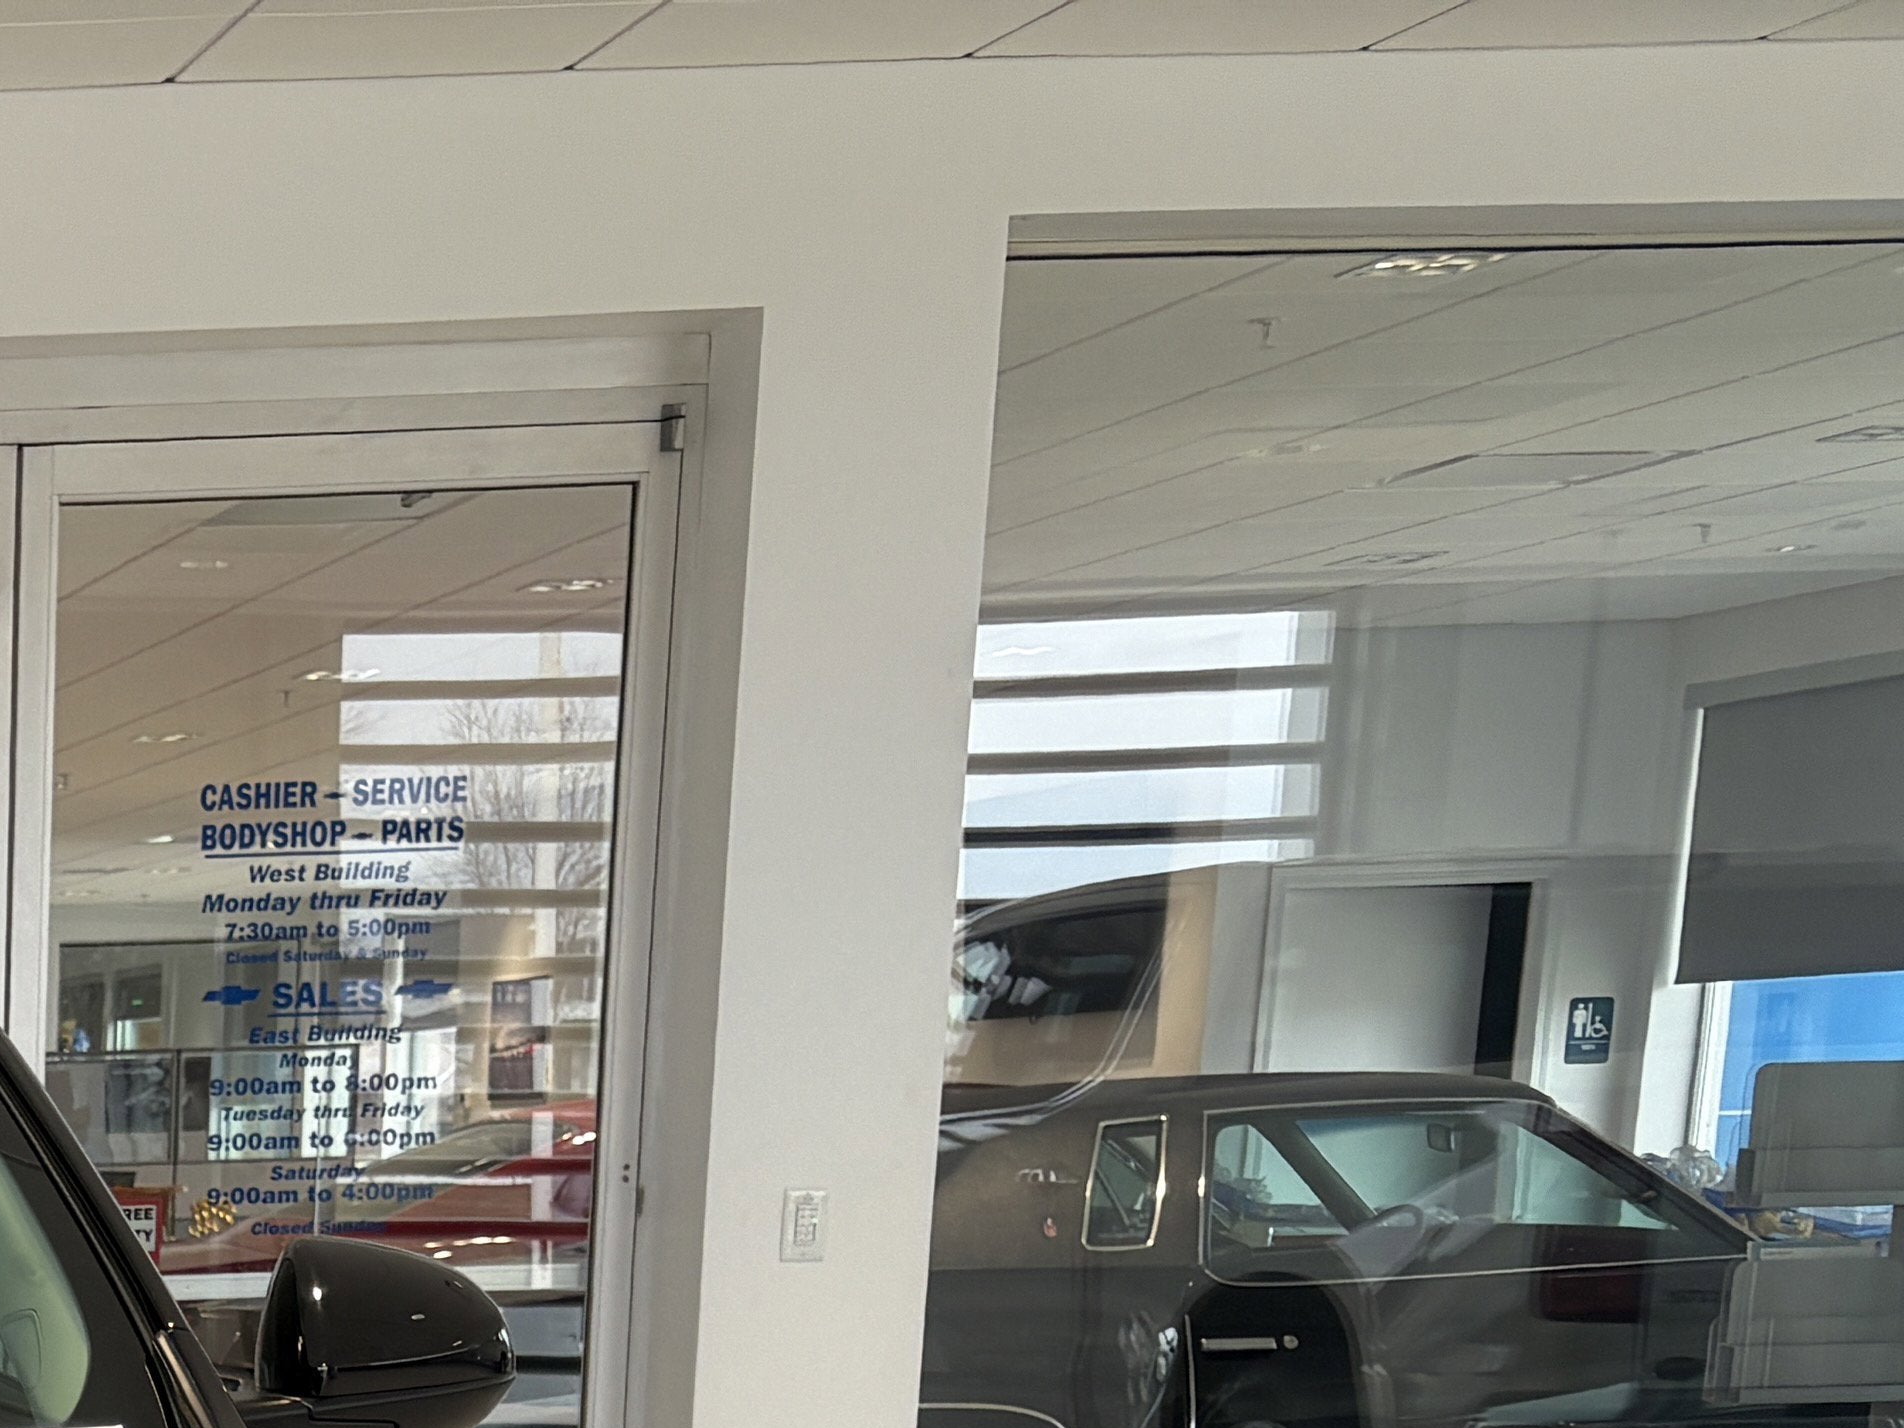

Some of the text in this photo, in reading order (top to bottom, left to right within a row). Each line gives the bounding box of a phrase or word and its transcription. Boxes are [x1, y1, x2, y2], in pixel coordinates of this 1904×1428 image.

[200, 775, 468, 812] CASHIER SERVICE
[201, 816, 464, 851] BODYSHOP PARTS
[249, 861, 412, 883] West Building
[202, 888, 448, 916] Monday thru Friday
[224, 918, 432, 941] 7:30am to 5:00pm
[225, 950, 279, 964] Closed
[283, 948, 350, 964] Saturday
[373, 947, 428, 961] Sunday
[272, 980, 384, 1009] SALES
[248, 1023, 404, 1044] East Building
[279, 1053, 356, 1070] Monday
[209, 1077, 302, 1097] 9:00am
[311, 1076, 336, 1093] to
[221, 1105, 306, 1122] Tuesday
[360, 1102, 426, 1120] Friday
[207, 1132, 300, 1151] 9:00am
[309, 1131, 334, 1148] to
[270, 1164, 368, 1184] Saturday
[207, 1183, 434, 1207] 9:00am to 4:00pm
[251, 1220, 314, 1236] Closed
